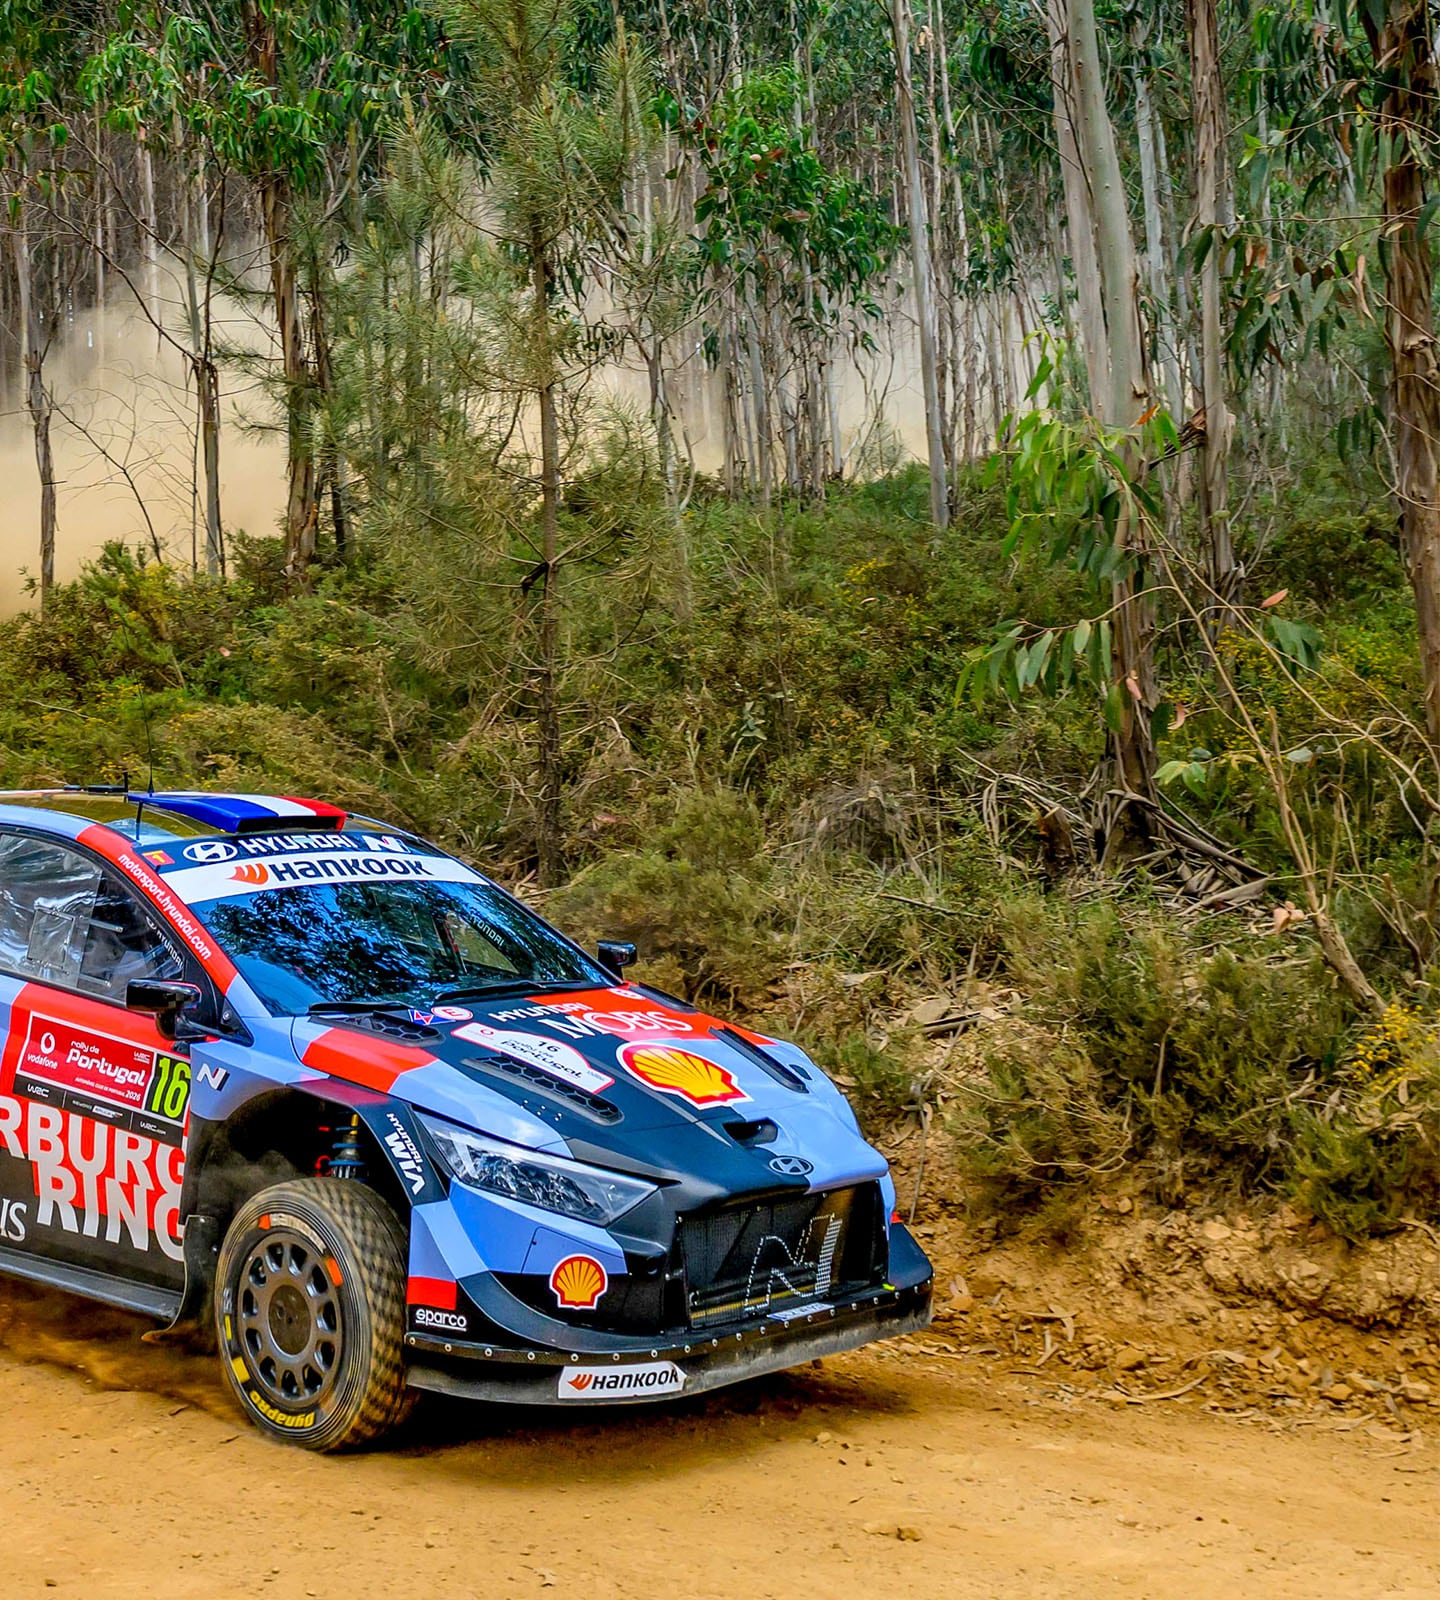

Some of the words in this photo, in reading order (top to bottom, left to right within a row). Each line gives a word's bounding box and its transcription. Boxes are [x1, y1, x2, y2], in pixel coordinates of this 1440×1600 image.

[239, 835, 359, 855] HYUNDAI
[117, 854, 212, 960] motorsport.hyundai.com
[488, 1003, 593, 1022] HYUNDAI
[538, 1011, 694, 1039] MOBIS
[71, 1041, 90, 1053] rally
[90, 1046, 100, 1055] de
[501, 1041, 582, 1078] Portugal
[538, 1041, 561, 1052] 16
[27, 1053, 58, 1070] vodafone
[66, 1049, 146, 1087] Portugal
[27, 1083, 50, 1098] WRC
[151, 1057, 191, 1119] 16
[385, 1113, 423, 1163] HYUNDAI
[384, 1131, 425, 1195] WIA
[36, 1159, 185, 1261] RING
[415, 1308, 467, 1329] sparco
